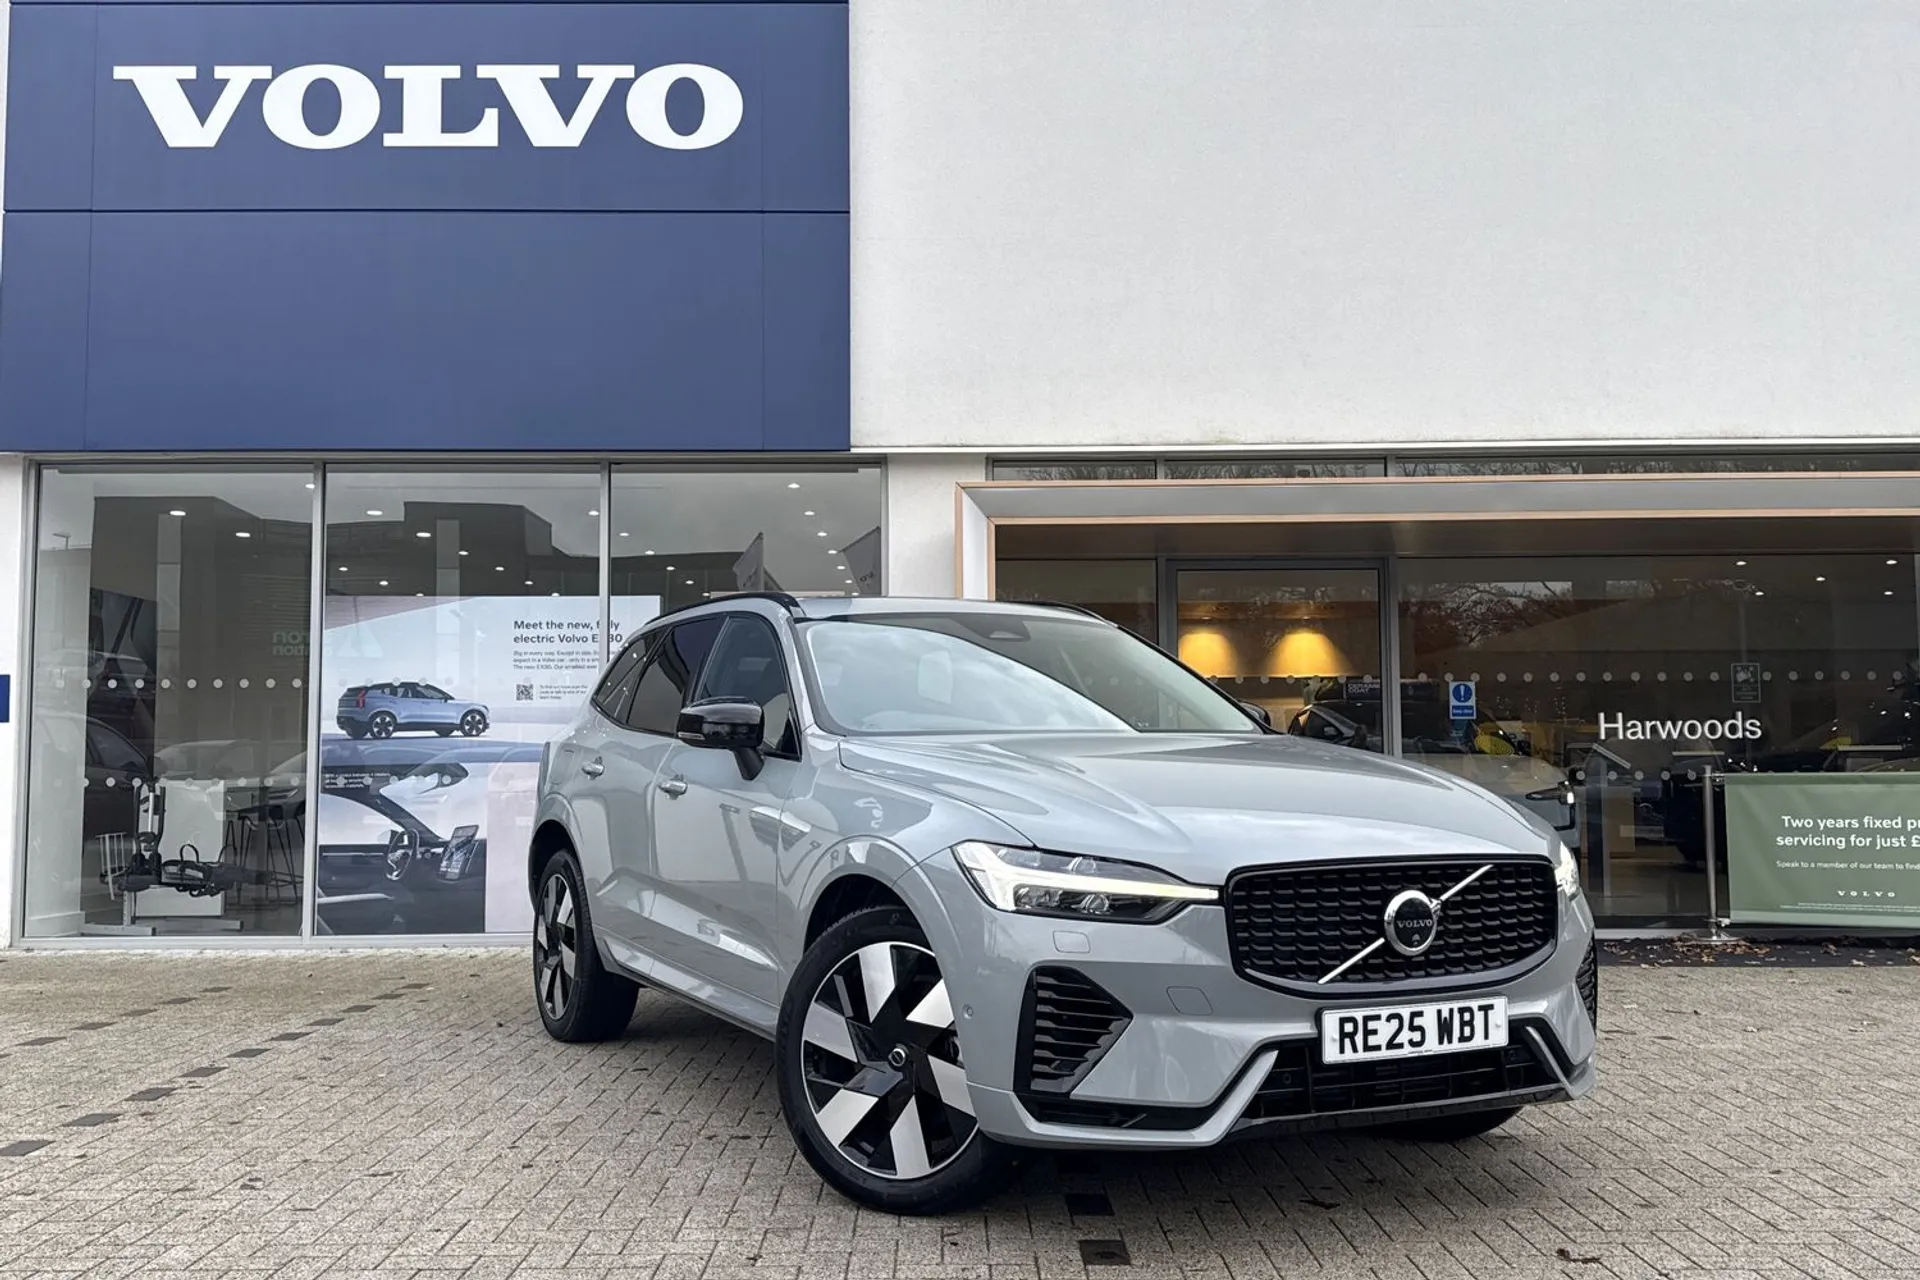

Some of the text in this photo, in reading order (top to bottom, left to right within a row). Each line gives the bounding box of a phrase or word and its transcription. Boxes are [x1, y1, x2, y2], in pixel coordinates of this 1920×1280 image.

[113, 63, 743, 150] VOLVO
[513, 620, 543, 630] Meet
[546, 620, 564, 630] the
[567, 622, 593, 631] new,
[513, 633, 555, 643] electric
[558, 633, 588, 643] Volvo
[1598, 711, 1762, 740] Harwoods
[1781, 815, 1814, 829] Two
[1817, 818, 1860, 831] years
[1863, 816, 1902, 829] fixed
[1776, 834, 1846, 849] servicing
[1850, 834, 1872, 847] for
[1875, 835, 1906, 850] just
[1776, 860, 1799, 869] Speak
[1817, 860, 1848, 869] member
[1849, 861, 1858, 869] of
[1874, 862, 1894, 870] team
[1895, 862, 1904, 870] to
[1396, 918, 1433, 929] VOLVO
[1338, 1003, 1494, 1055] RE25 WBT
